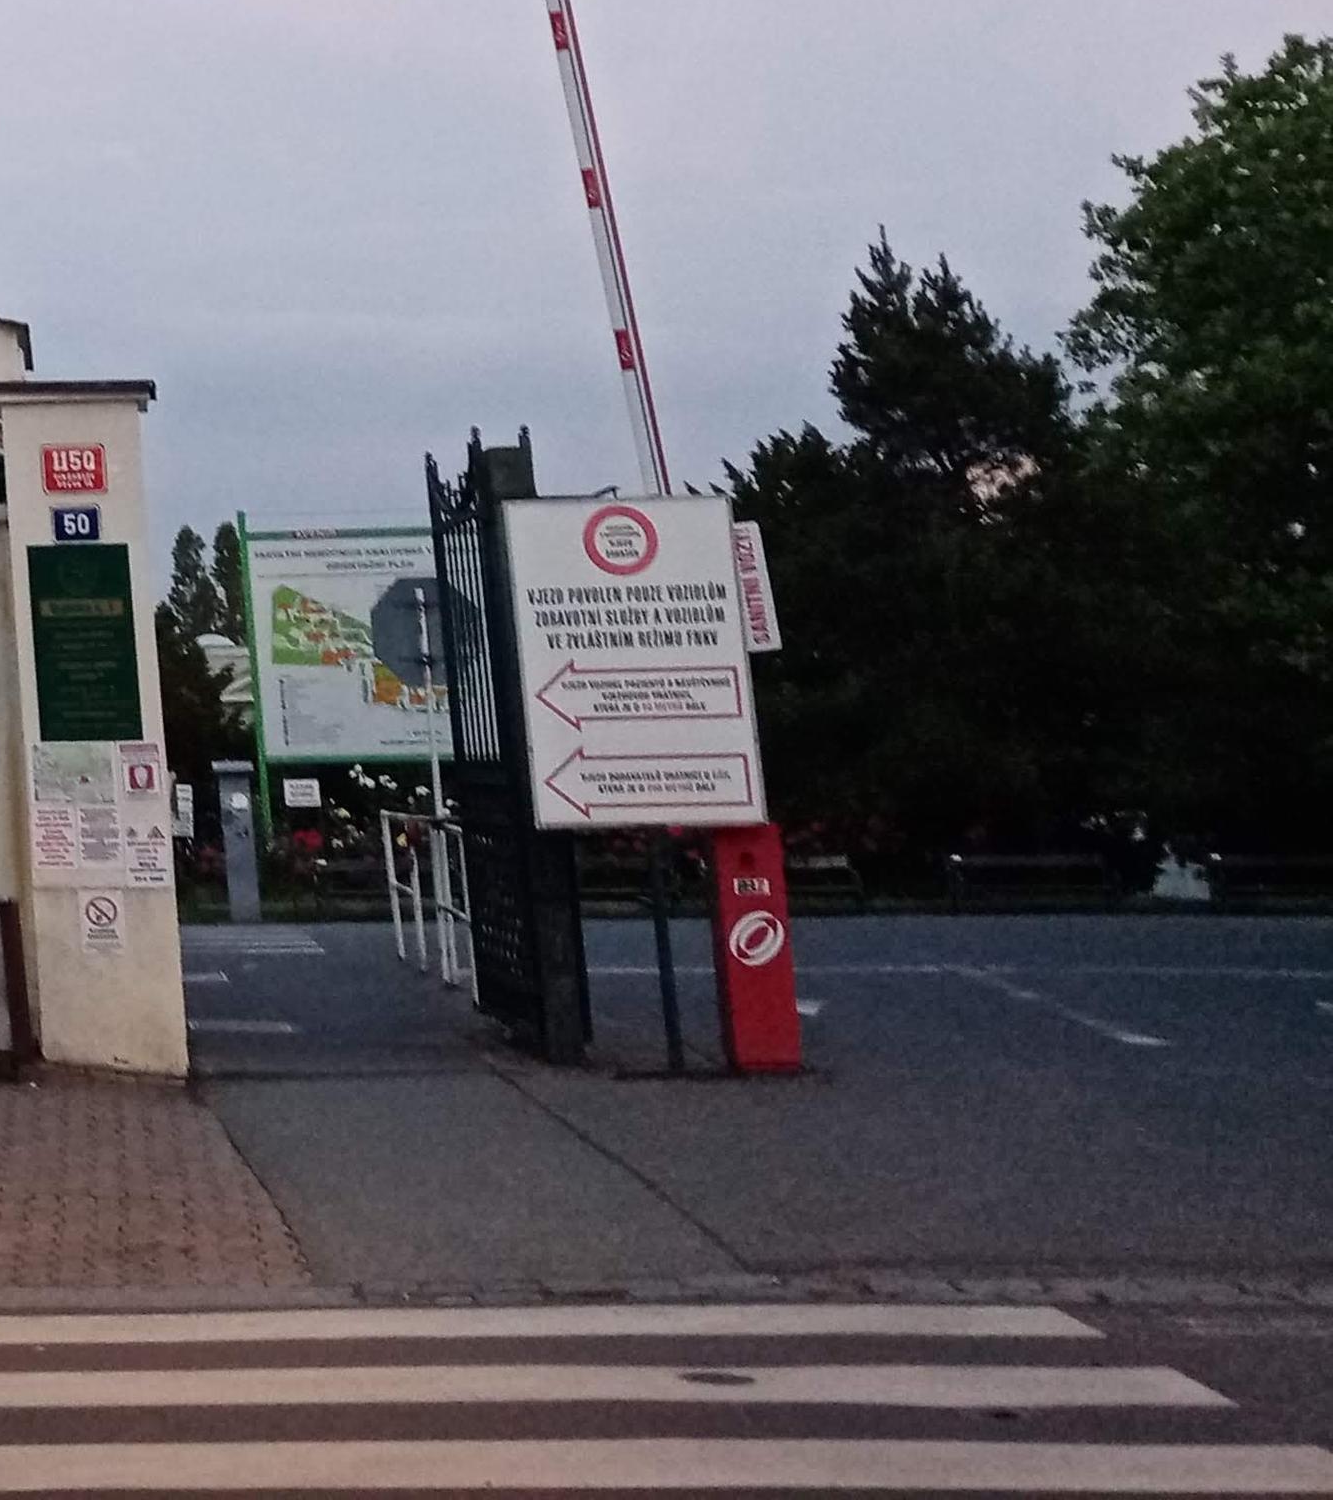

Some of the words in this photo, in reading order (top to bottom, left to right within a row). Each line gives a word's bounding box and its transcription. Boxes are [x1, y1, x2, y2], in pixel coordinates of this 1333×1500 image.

[63, 512, 90, 536] 50
[527, 587, 564, 605] VJEZD
[567, 586, 622, 604] POVOLEN
[626, 584, 663, 602] POUZE
[666, 580, 727, 601] VOZIDLŮM
[534, 607, 601, 627] ZDRAVOTNÍ
[605, 606, 648, 626] SLUŽBY
[654, 607, 662, 625] A
[664, 603, 725, 624] VOZIDLŮM
[546, 632, 562, 649] VE
